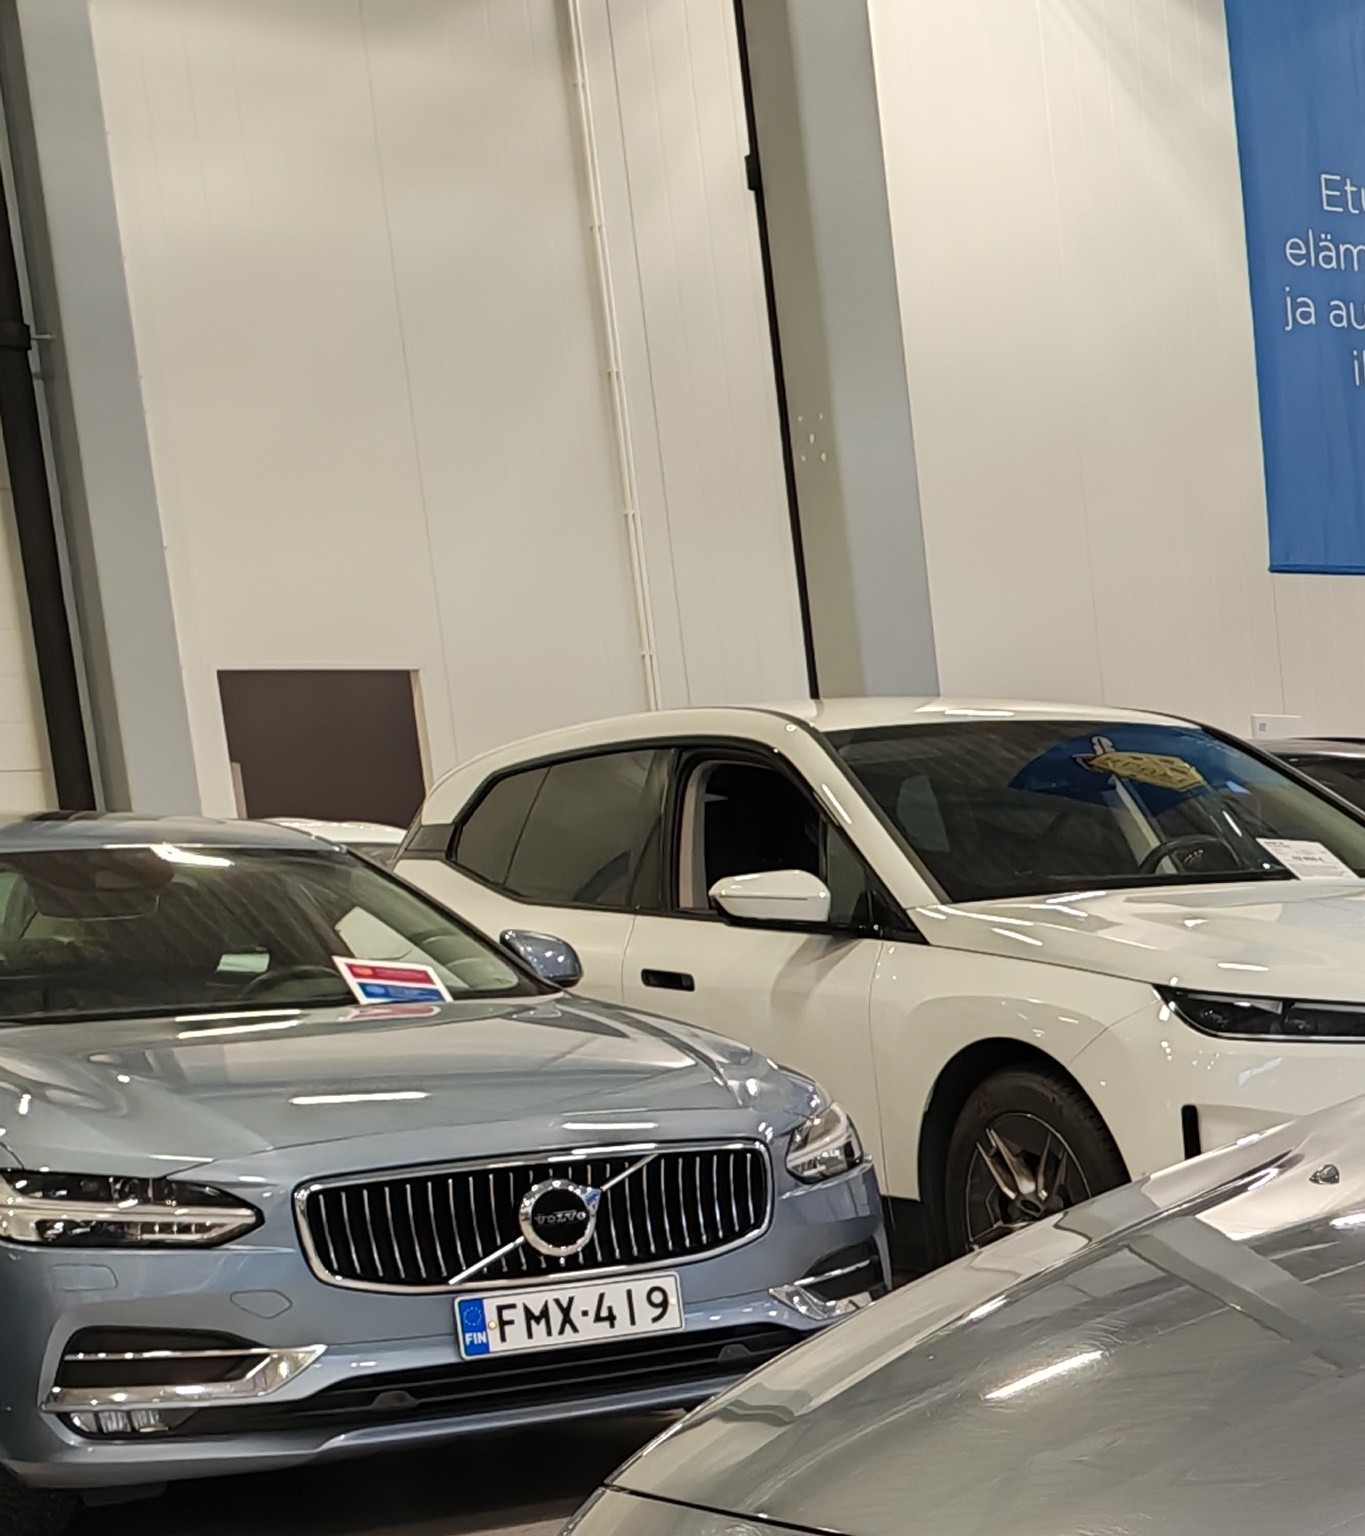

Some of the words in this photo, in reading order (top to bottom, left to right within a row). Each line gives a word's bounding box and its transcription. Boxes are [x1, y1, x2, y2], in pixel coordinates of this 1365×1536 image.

[1285, 286, 1316, 331] ja
[465, 1331, 487, 1346] FIN
[496, 1286, 669, 1343] FMX-419
